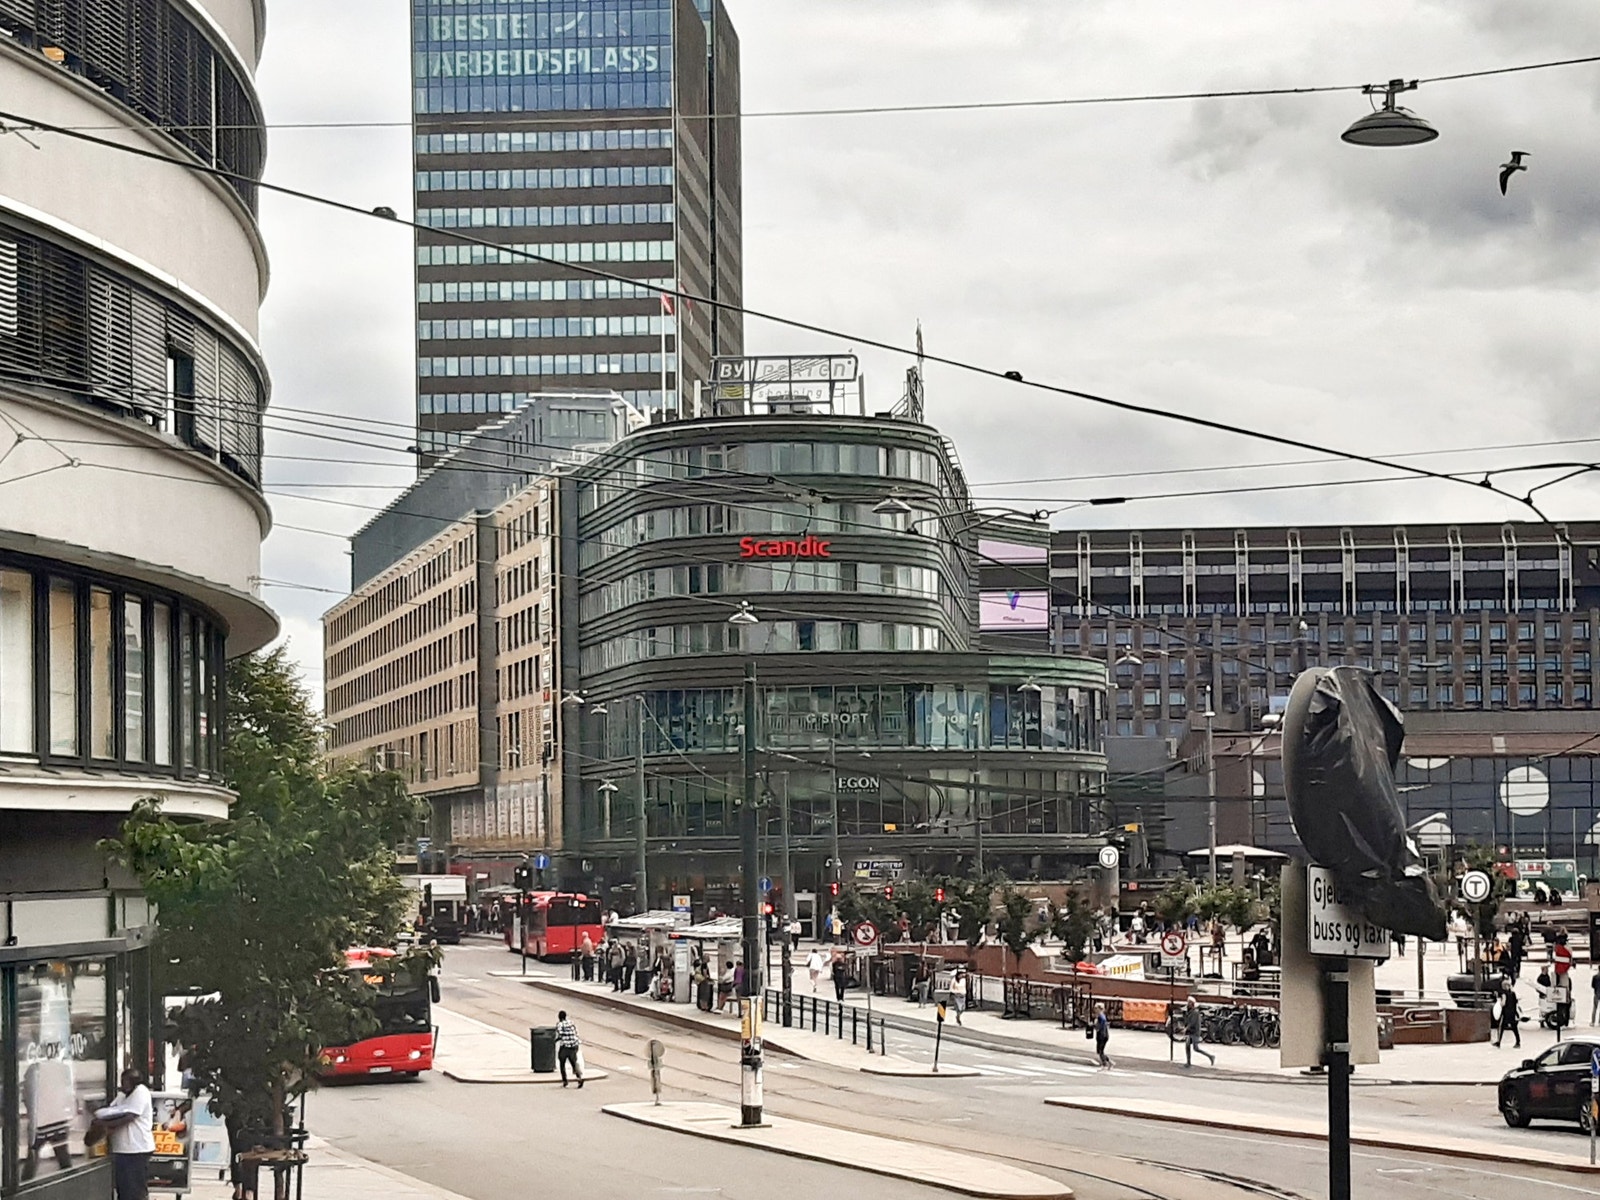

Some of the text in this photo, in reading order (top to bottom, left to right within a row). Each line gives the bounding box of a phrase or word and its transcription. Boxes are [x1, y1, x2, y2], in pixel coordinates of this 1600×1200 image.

[431, 13, 529, 41] BESTE
[432, 45, 659, 77] ARBEIDSPLASS
[740, 536, 831, 557] Scandic
[838, 777, 880, 789] EGON
[1314, 915, 1387, 949] buss og taxi
